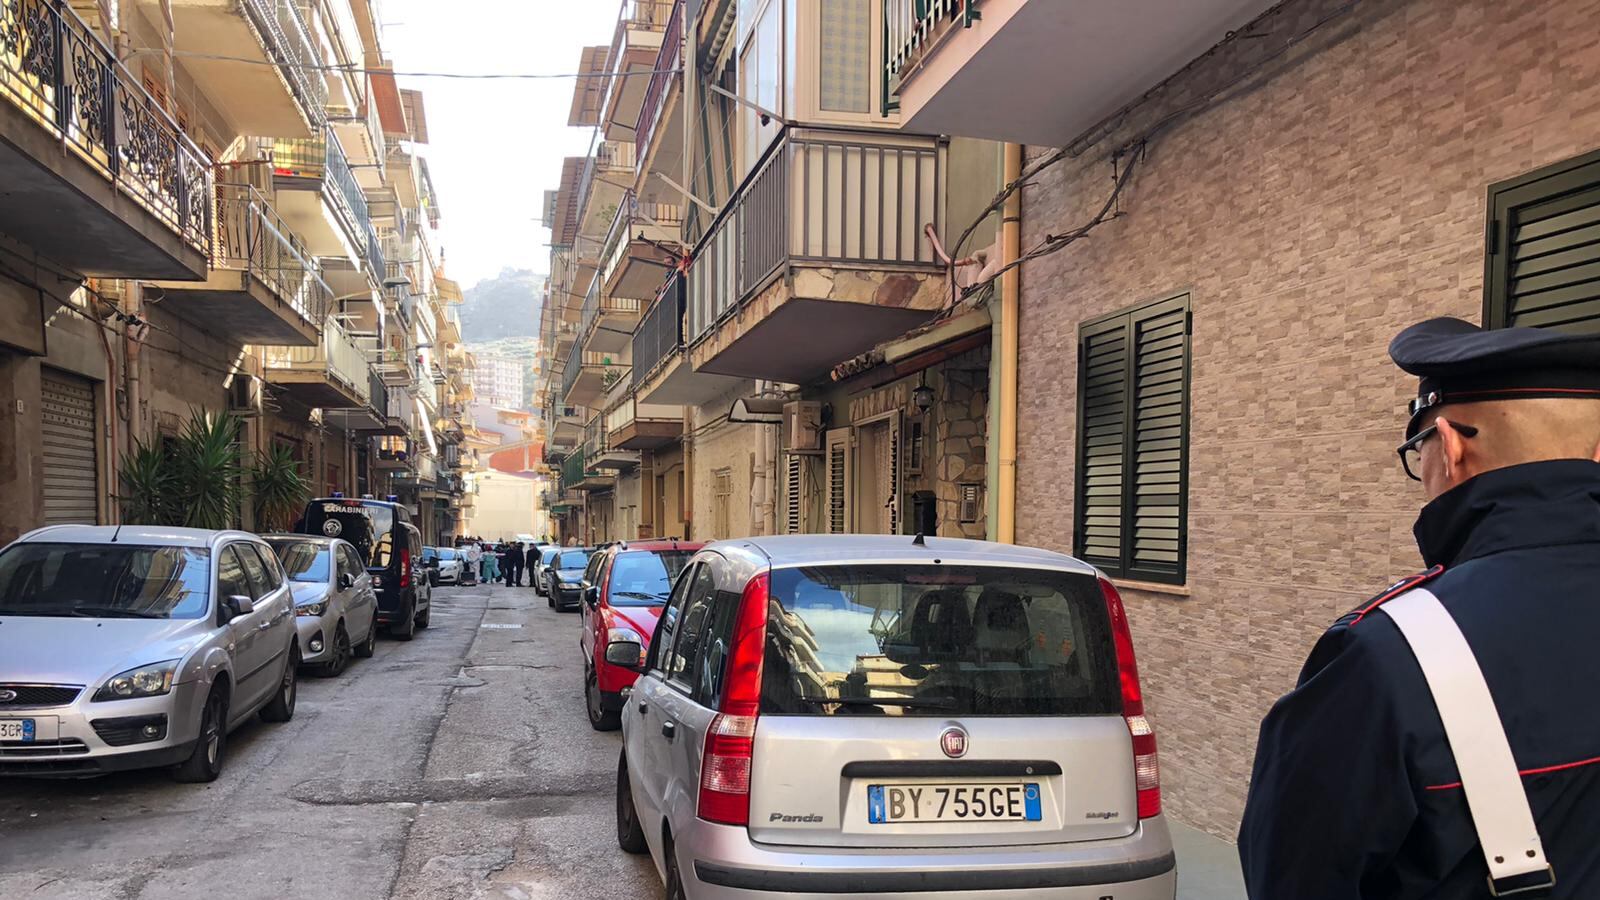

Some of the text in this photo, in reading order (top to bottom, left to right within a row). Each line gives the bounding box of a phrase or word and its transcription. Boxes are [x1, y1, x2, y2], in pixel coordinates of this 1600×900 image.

[324, 503, 378, 514] CARABINIERI
[946, 736, 963, 751] FIAT
[889, 787, 1022, 819] BY 755GE
[769, 812, 823, 822] Panda
